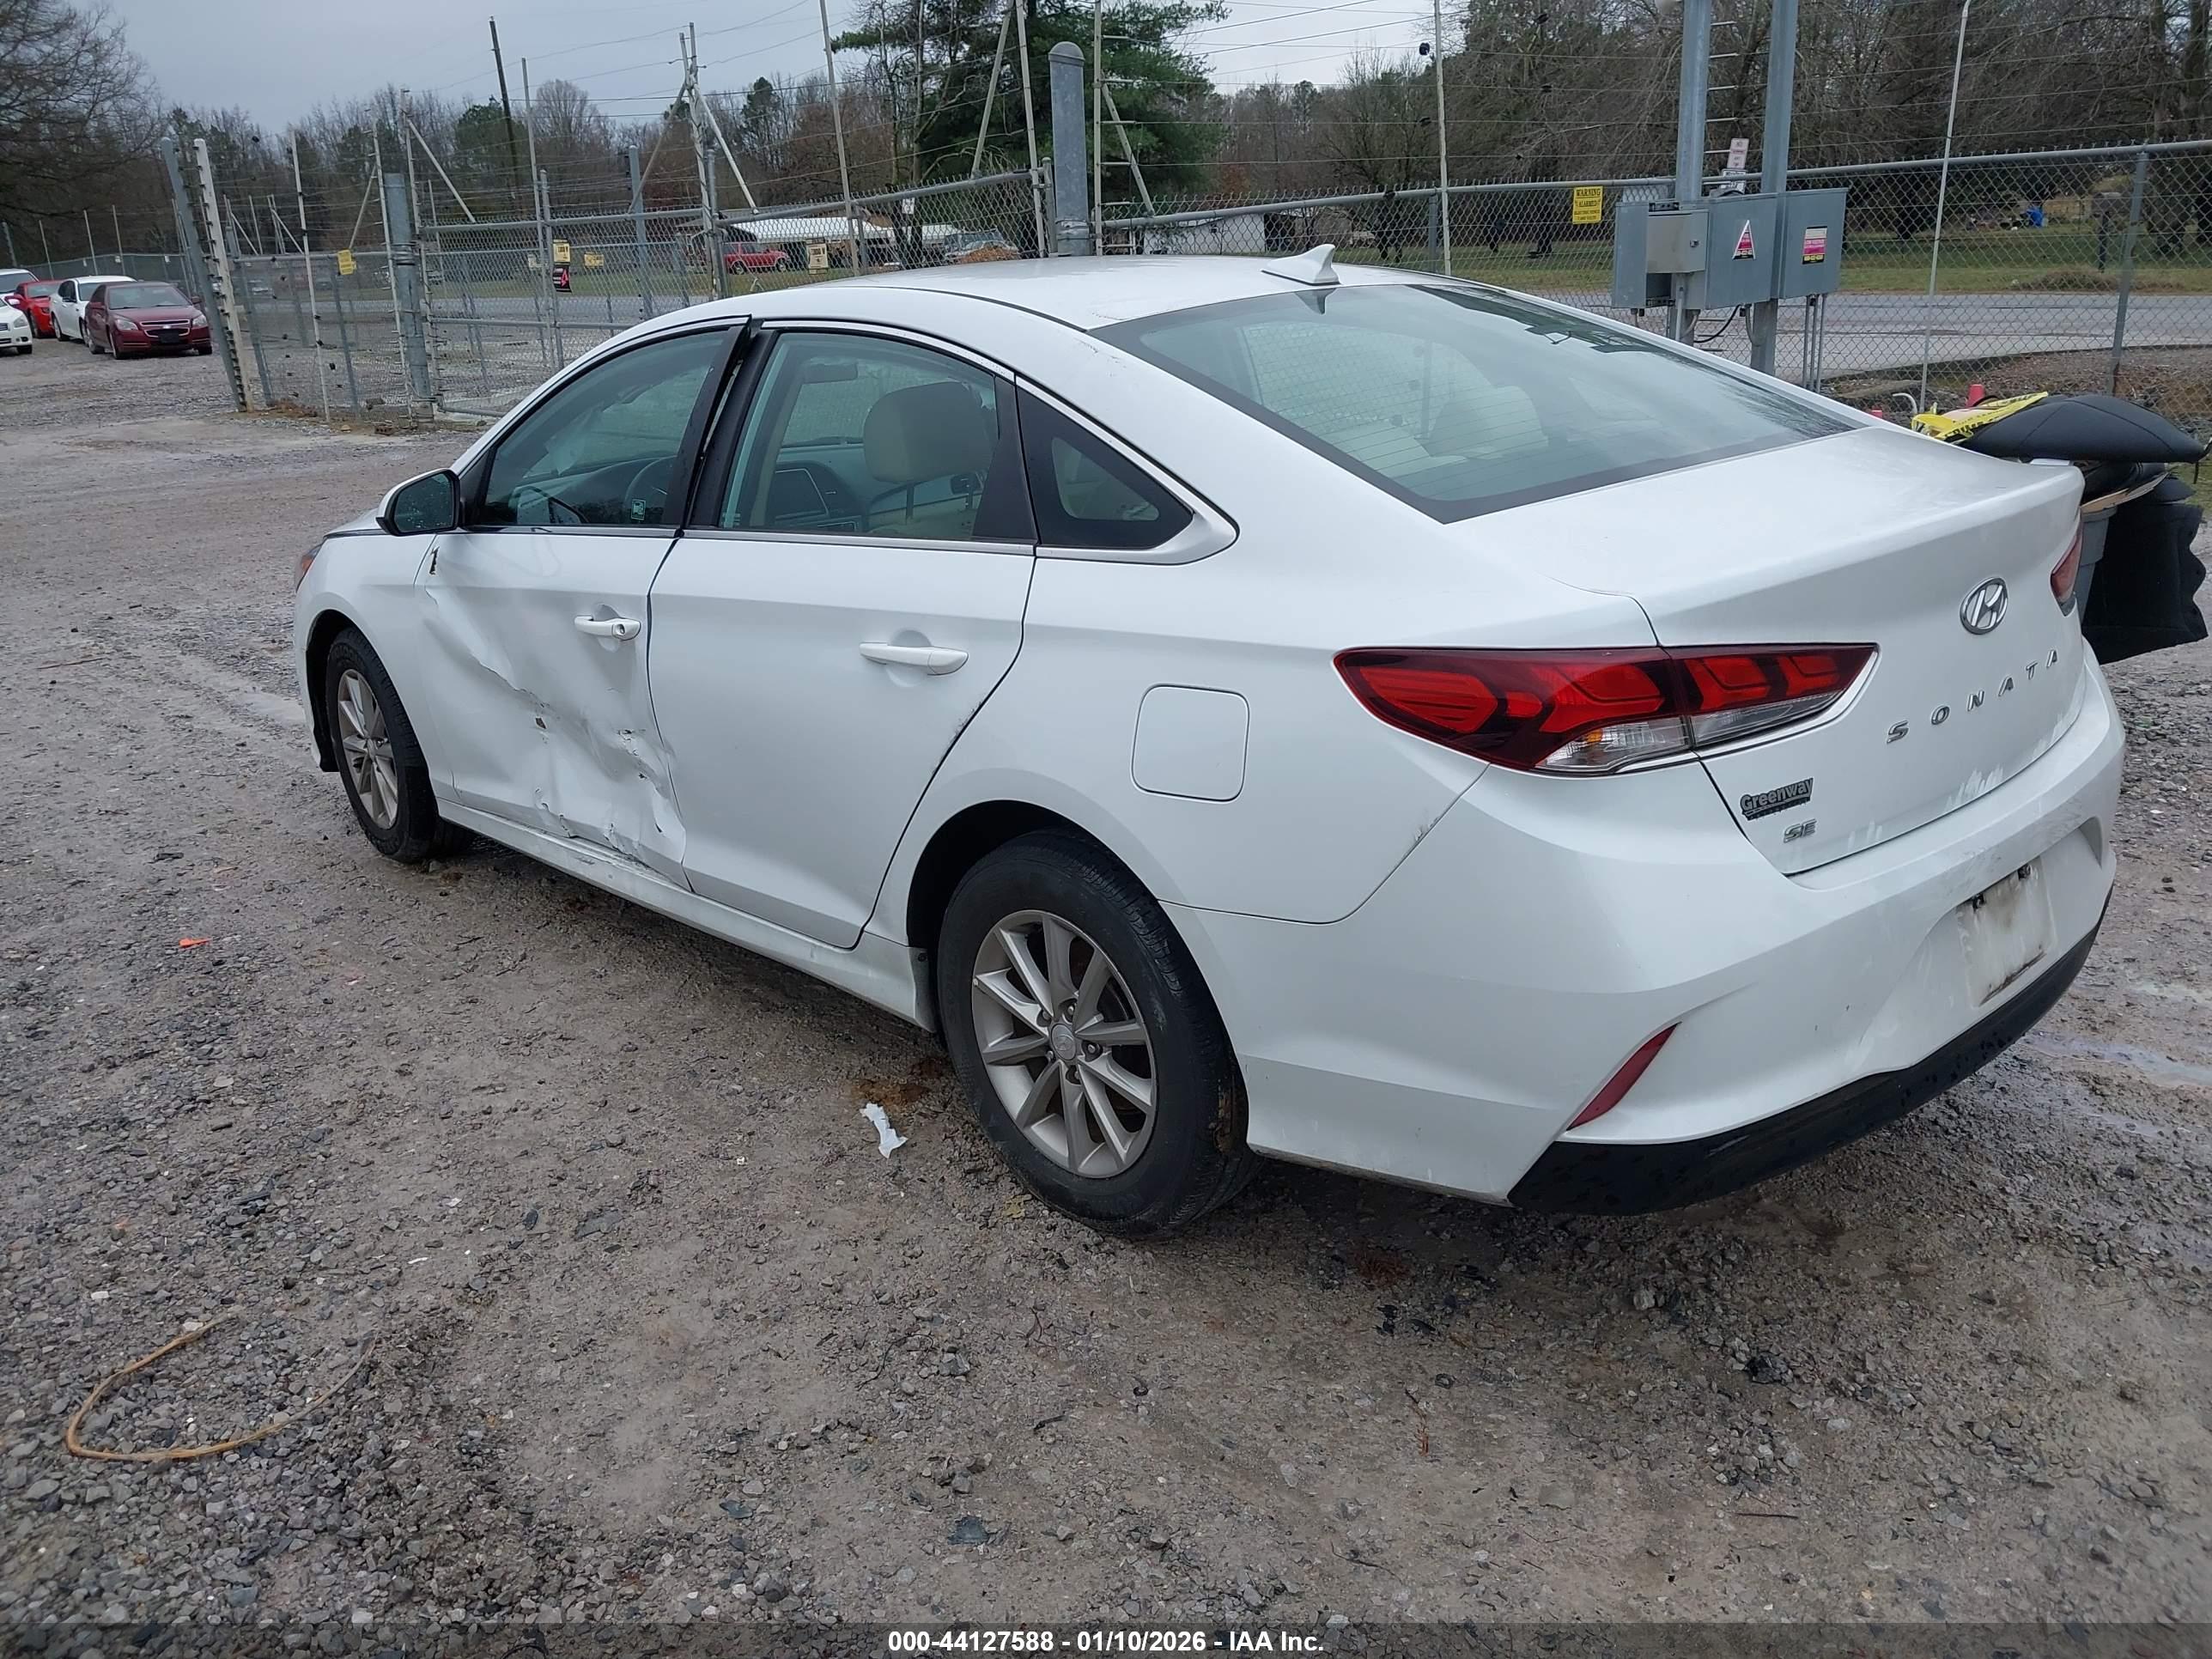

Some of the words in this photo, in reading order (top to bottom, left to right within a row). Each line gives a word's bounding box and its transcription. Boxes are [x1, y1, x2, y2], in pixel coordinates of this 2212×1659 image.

[1576, 188, 1601, 197] WARNING
[1887, 648, 2058, 744] SONATA
[1741, 777, 1813, 812] Greenway
[1784, 818, 1817, 843] SE
